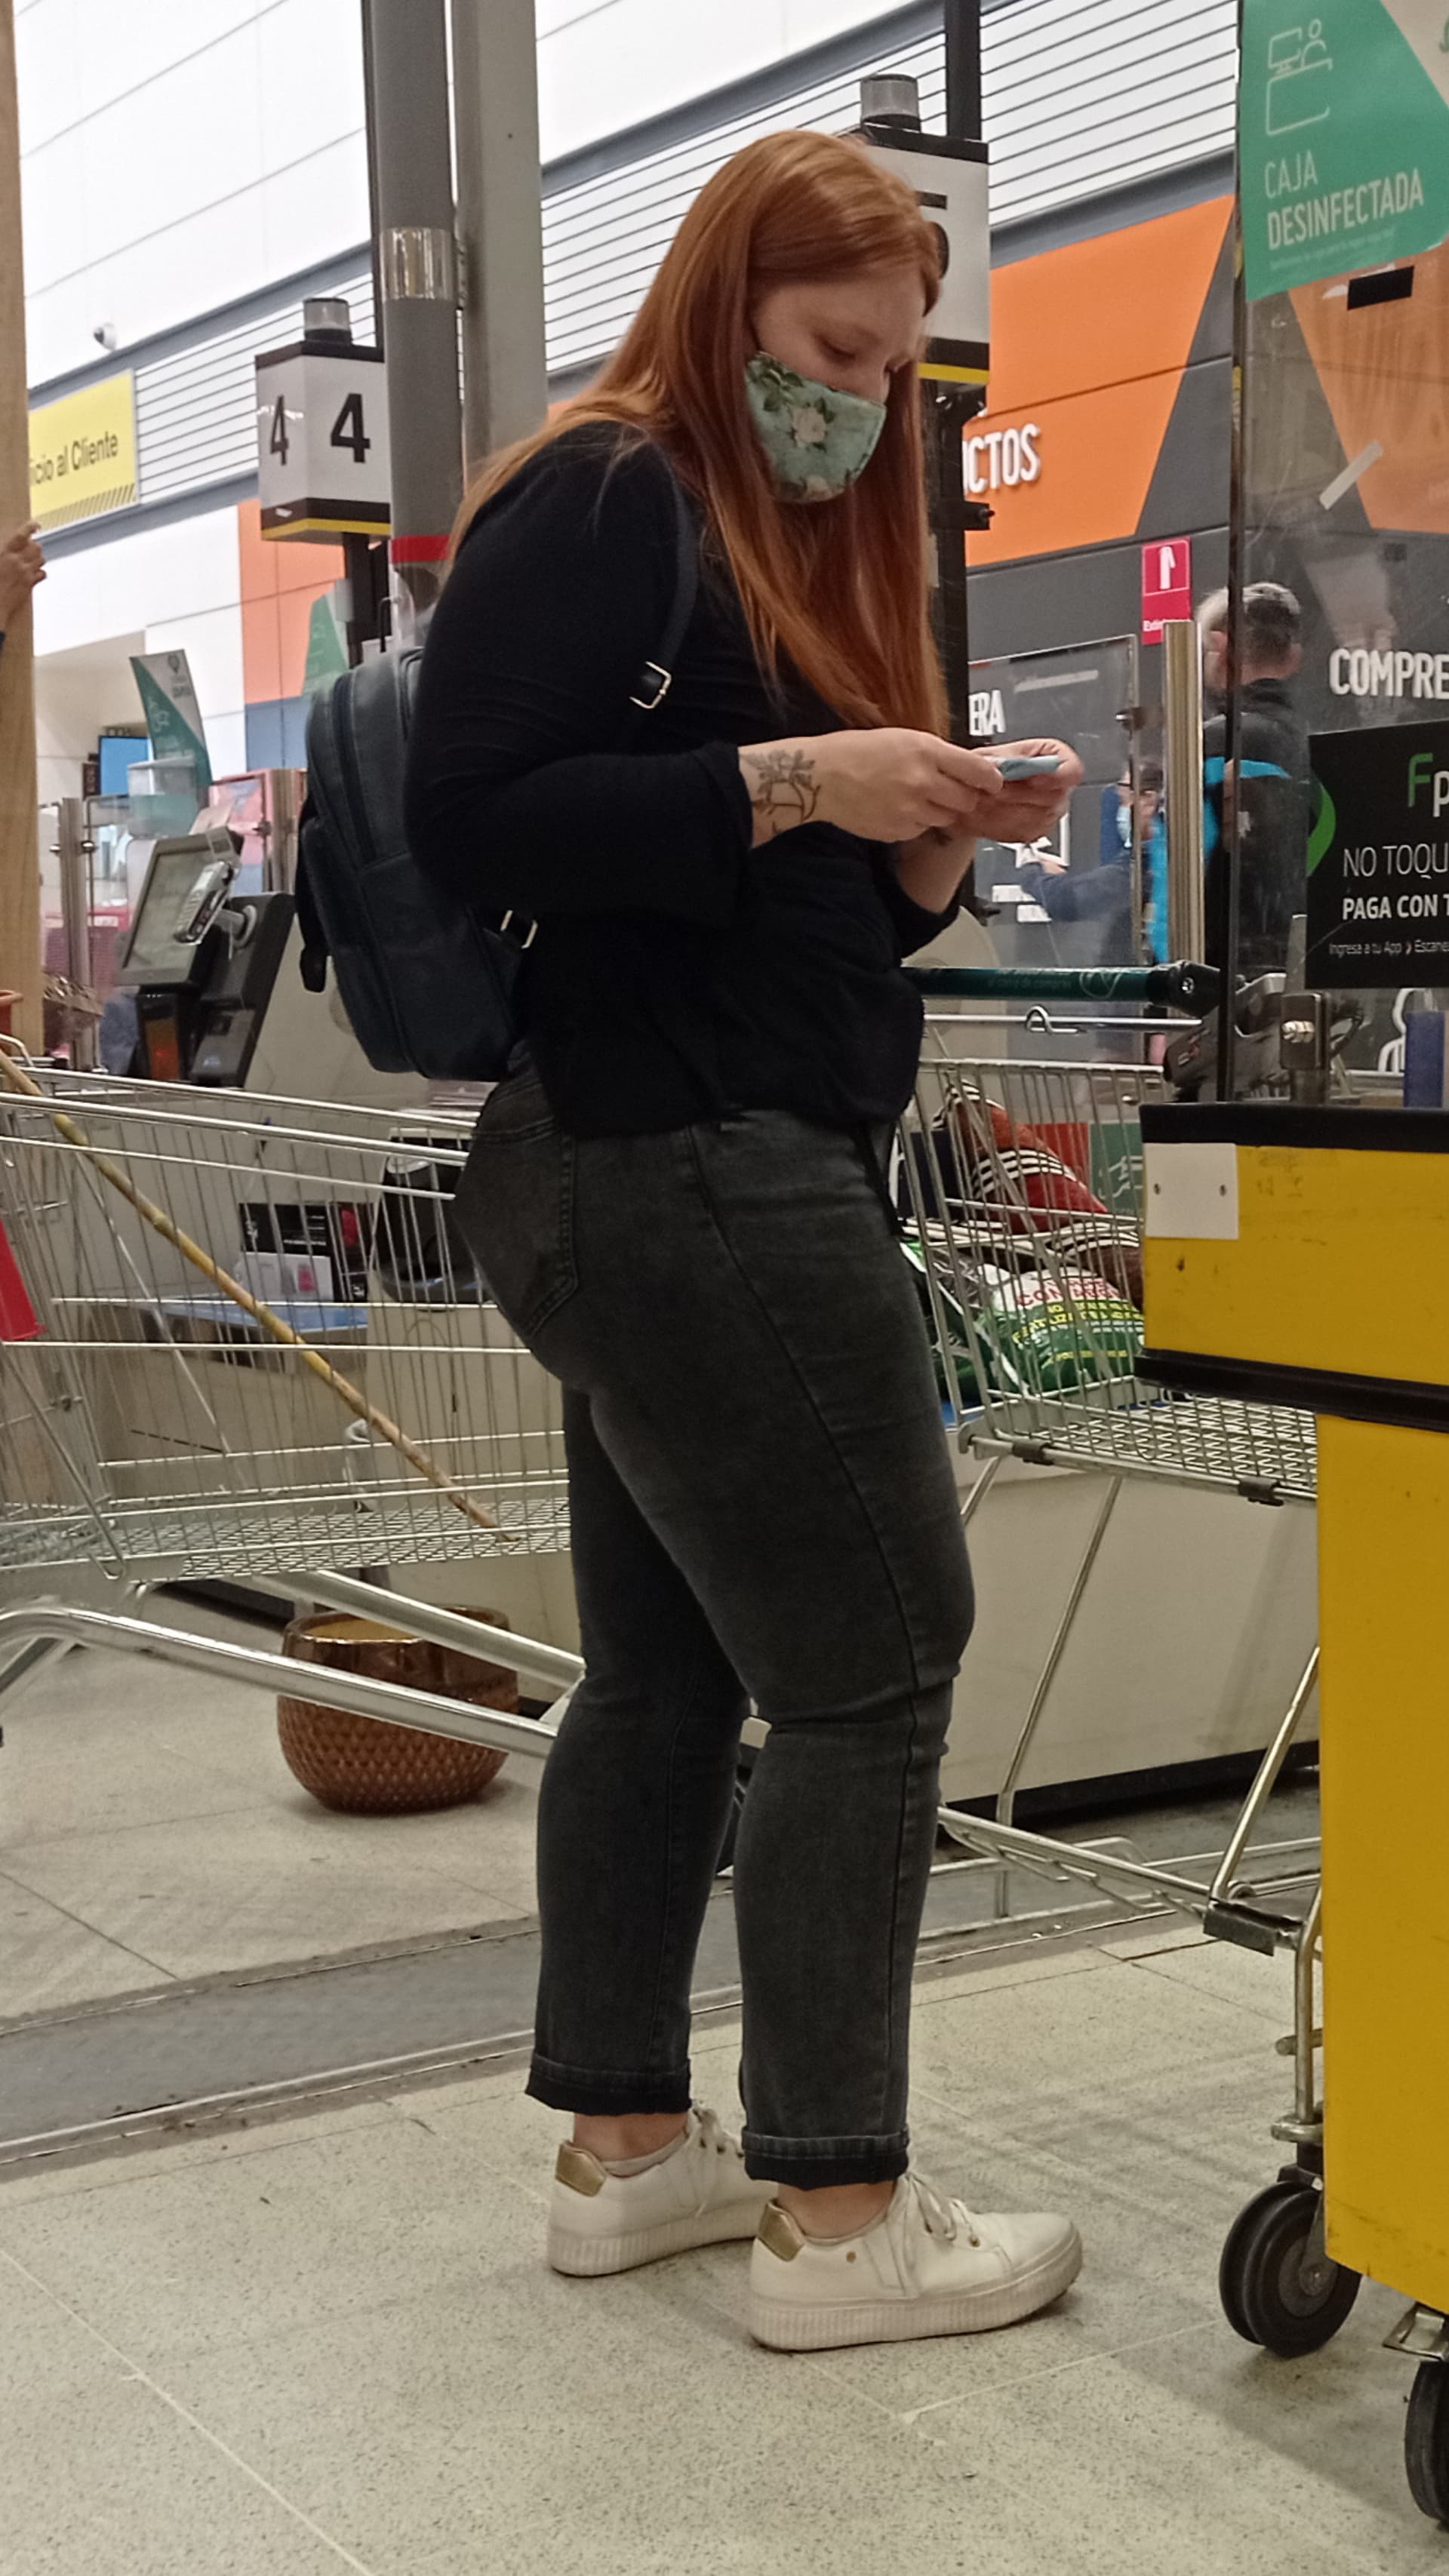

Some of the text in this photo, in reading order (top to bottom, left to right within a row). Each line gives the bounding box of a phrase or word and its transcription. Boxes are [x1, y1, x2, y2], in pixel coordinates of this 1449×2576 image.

[1265, 151, 1318, 198] CAJA
[1267, 168, 1424, 250] DESINFECTADA
[270, 395, 289, 466] 4
[331, 393, 371, 463] 4
[57, 445, 68, 477] al
[72, 431, 117, 471] Cliente
[1329, 648, 1449, 699] COMPRE
[968, 690, 1006, 736] ERA
[1343, 842, 1449, 878] NO TOQU
[1342, 896, 1392, 920] PAGA
[1397, 894, 1438, 918] CON
